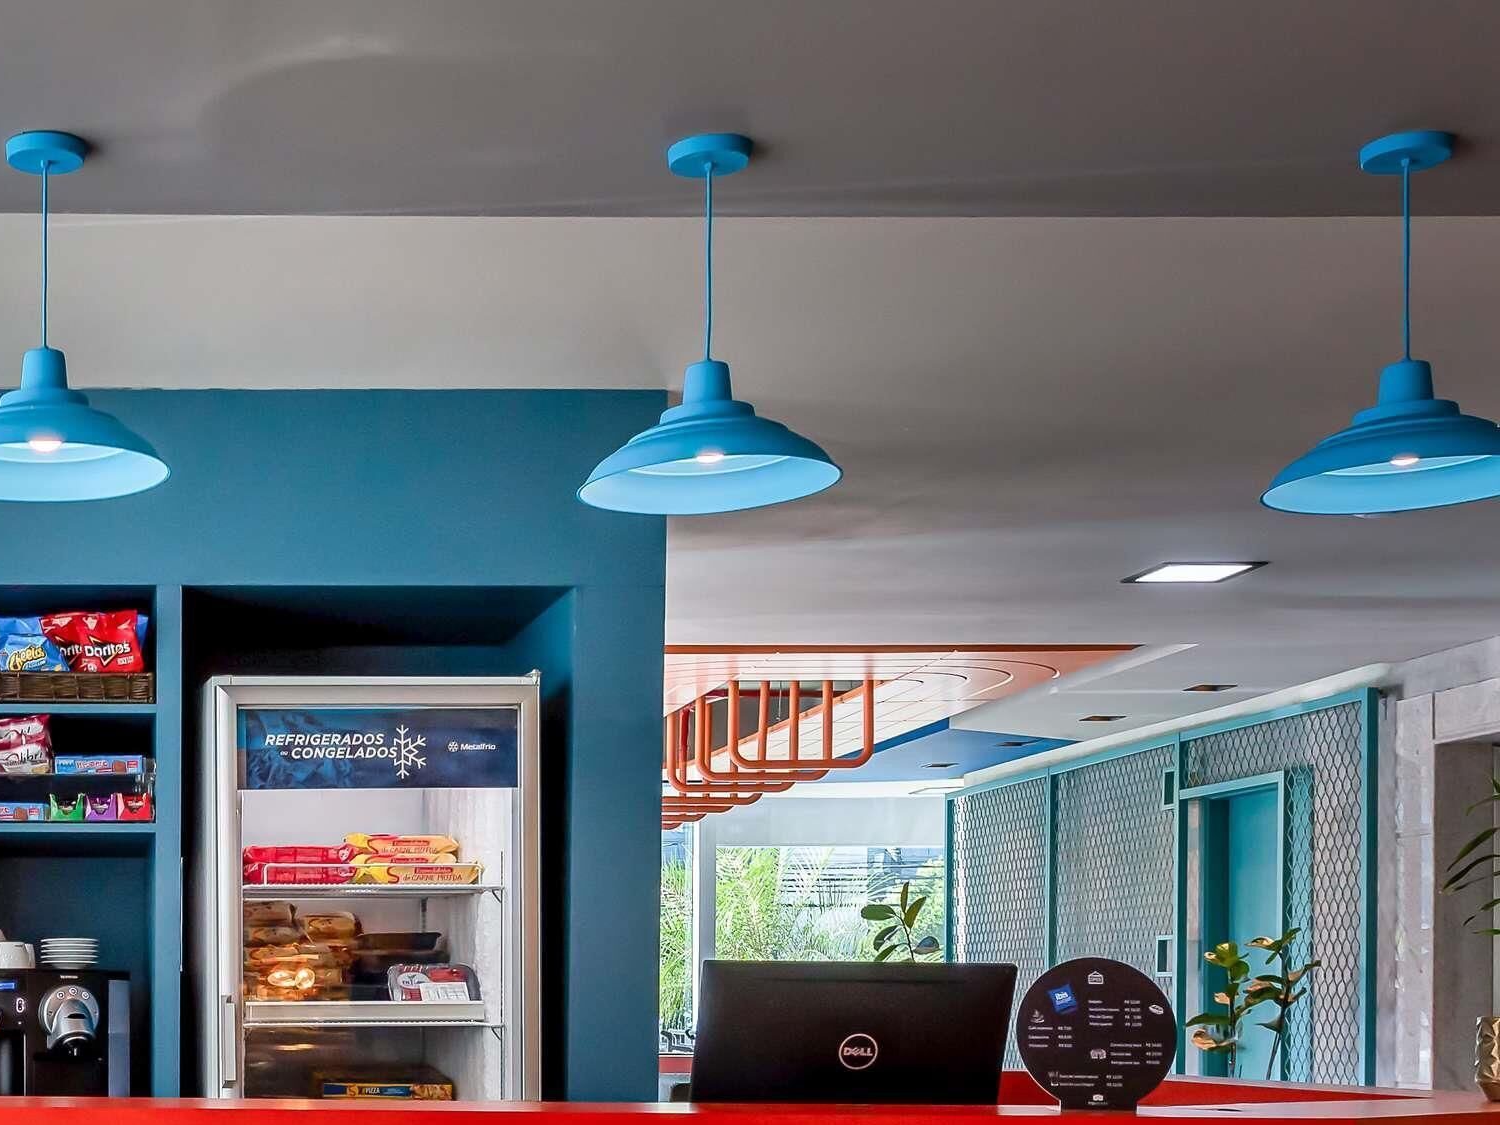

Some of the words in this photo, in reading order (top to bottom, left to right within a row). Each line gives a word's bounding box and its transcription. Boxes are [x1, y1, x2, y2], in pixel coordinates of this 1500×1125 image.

[84, 641, 131, 657] Doritos
[8, 646, 46, 671] Cheetos
[265, 733, 385, 746] REFRIGERADOS
[291, 747, 399, 759] CONGELADOS
[460, 743, 496, 751] Metalfrio
[843, 1047, 873, 1057] DELL
